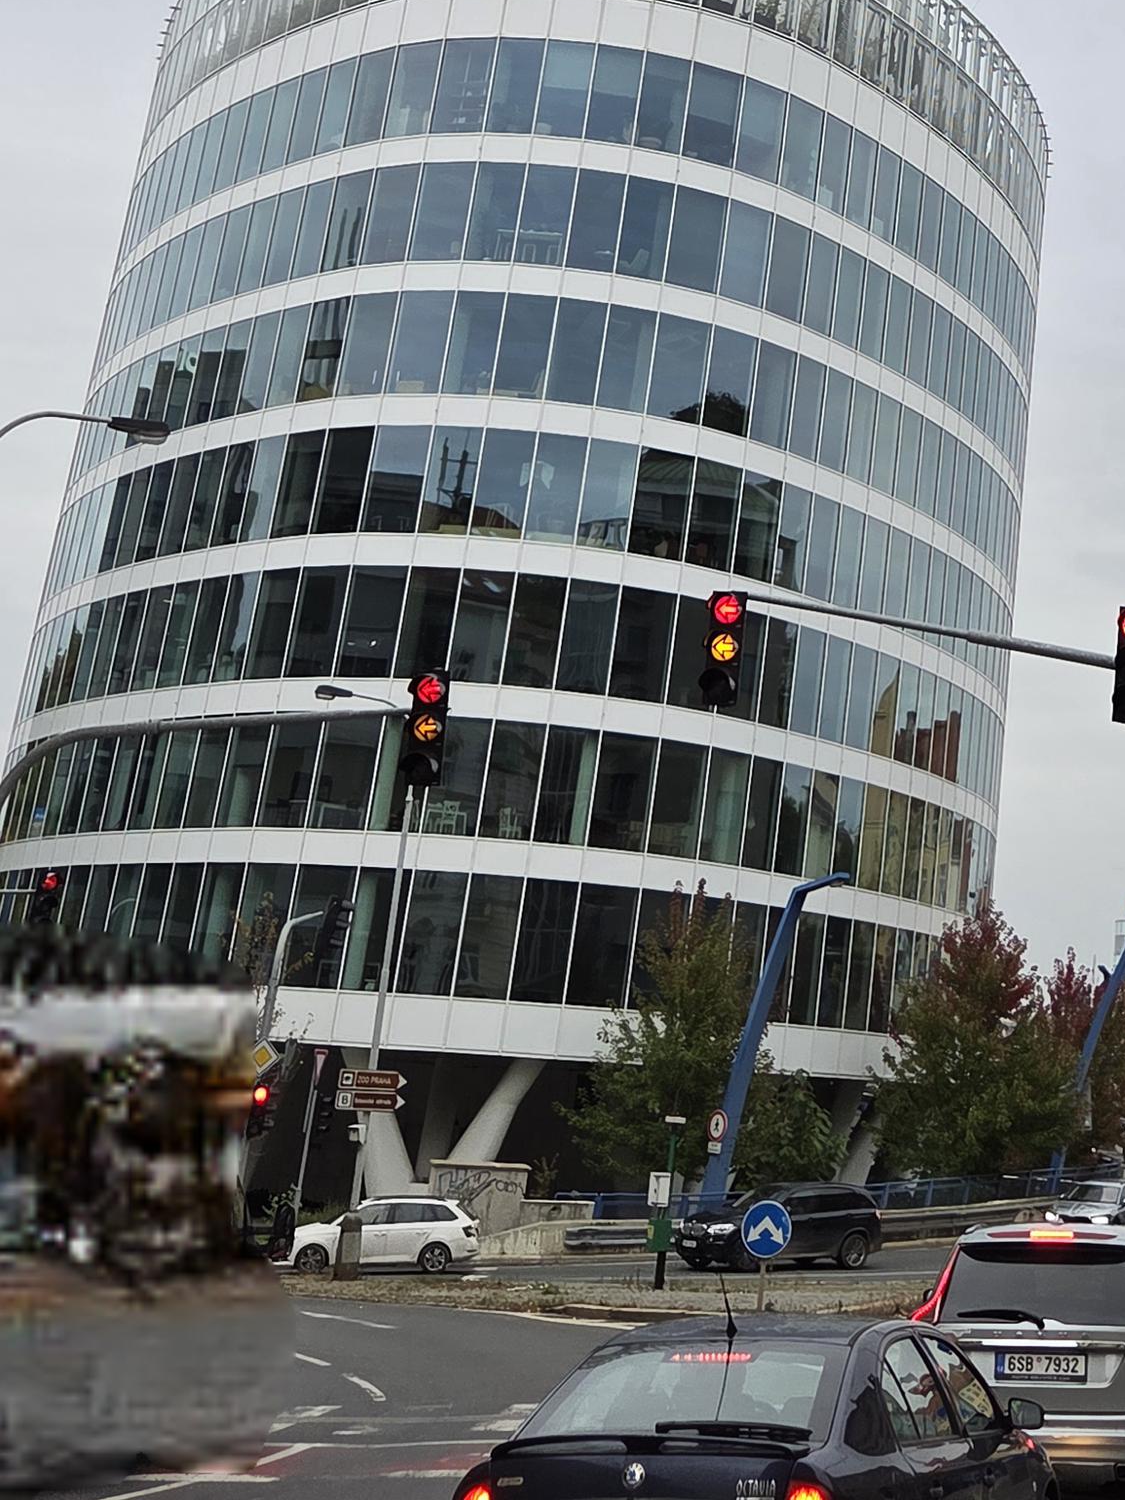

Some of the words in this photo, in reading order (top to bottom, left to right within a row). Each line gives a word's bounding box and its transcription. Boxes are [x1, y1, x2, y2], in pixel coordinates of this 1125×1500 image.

[357, 1075, 370, 1085] ZOO
[1007, 1355, 1034, 1372] 6SB
[1044, 1356, 1080, 1373] 7932
[735, 1479, 776, 1496] OCTAVIA
